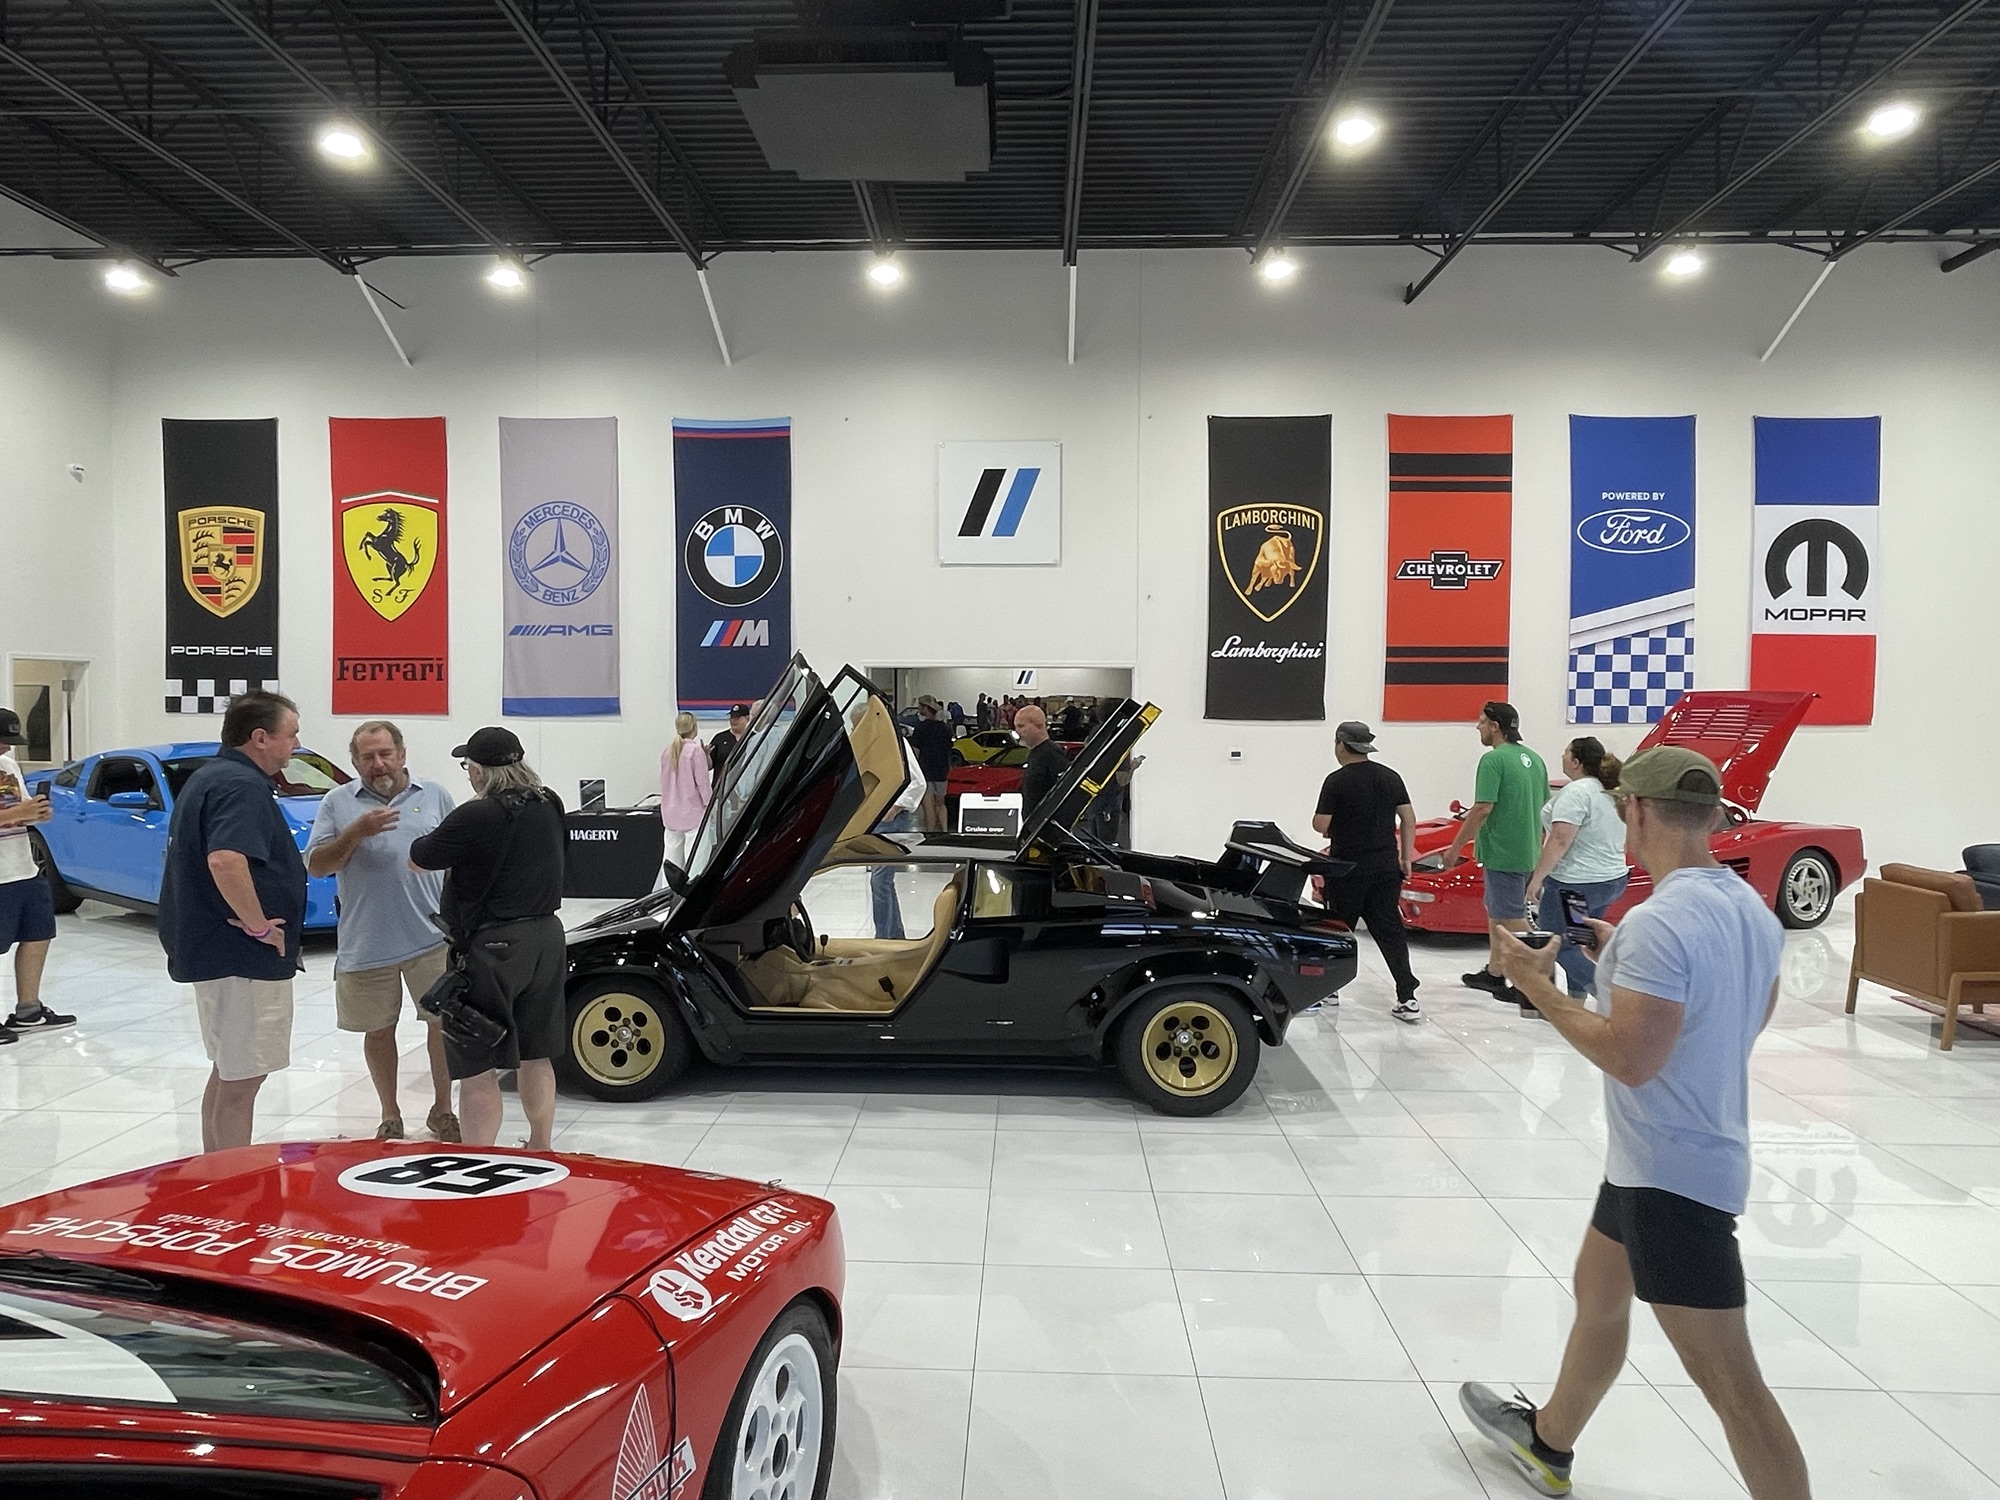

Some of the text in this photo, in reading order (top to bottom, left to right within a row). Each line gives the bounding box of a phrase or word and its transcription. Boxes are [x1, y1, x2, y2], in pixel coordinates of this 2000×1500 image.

[1602, 492, 1665, 501] POWERED BY
[187, 516, 255, 528] PORSCHE
[524, 504, 595, 531] MERCEDES
[694, 508, 776, 542] BMW
[1225, 509, 1316, 531] LAMBORGHINI
[1600, 513, 1667, 545] Ford
[1406, 563, 1492, 576] CHEVROLET
[371, 588, 383, 604] S
[542, 589, 579, 604] BENZ
[1764, 607, 1867, 622] MOPAR
[170, 645, 273, 656] PORSCHE
[1211, 635, 1324, 664] Lamborghini
[336, 657, 444, 682] Ferrari
[569, 829, 619, 841] HAGERTY
[354, 1156, 555, 1195] 58
[158, 1213, 251, 1232] Florida
[674, 1200, 798, 1281] Kendall GT-1
[726, 1220, 812, 1282] MOTOR OIL
[8, 1217, 489, 1301] BRUMOS PORSCHE
